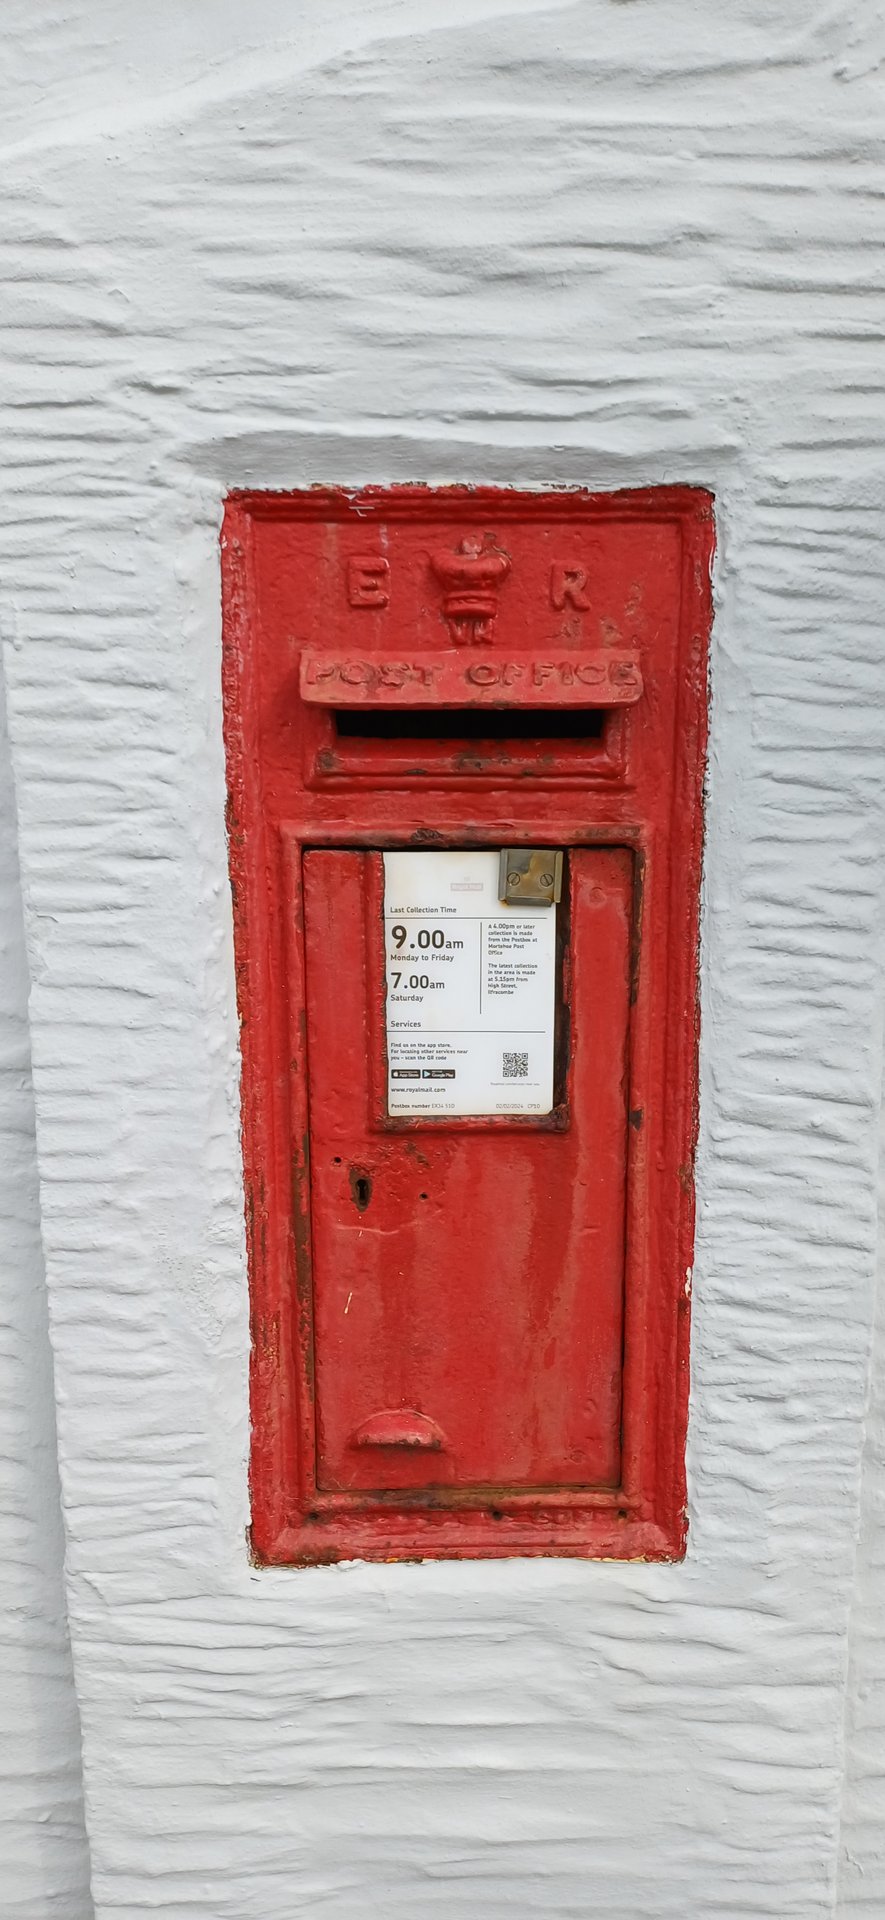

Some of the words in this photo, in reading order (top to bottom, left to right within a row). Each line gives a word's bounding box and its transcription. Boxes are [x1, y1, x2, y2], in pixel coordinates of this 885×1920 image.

[349, 556, 390, 609] E
[551, 559, 591, 612] R
[305, 660, 444, 688] POST
[466, 660, 639, 688] OFFICE
[391, 925, 464, 949] 9.00am
[390, 954, 420, 962] Monday
[432, 954, 454, 962] Friday
[390, 972, 445, 989] 7.00am
[390, 994, 424, 1002] Saturday
